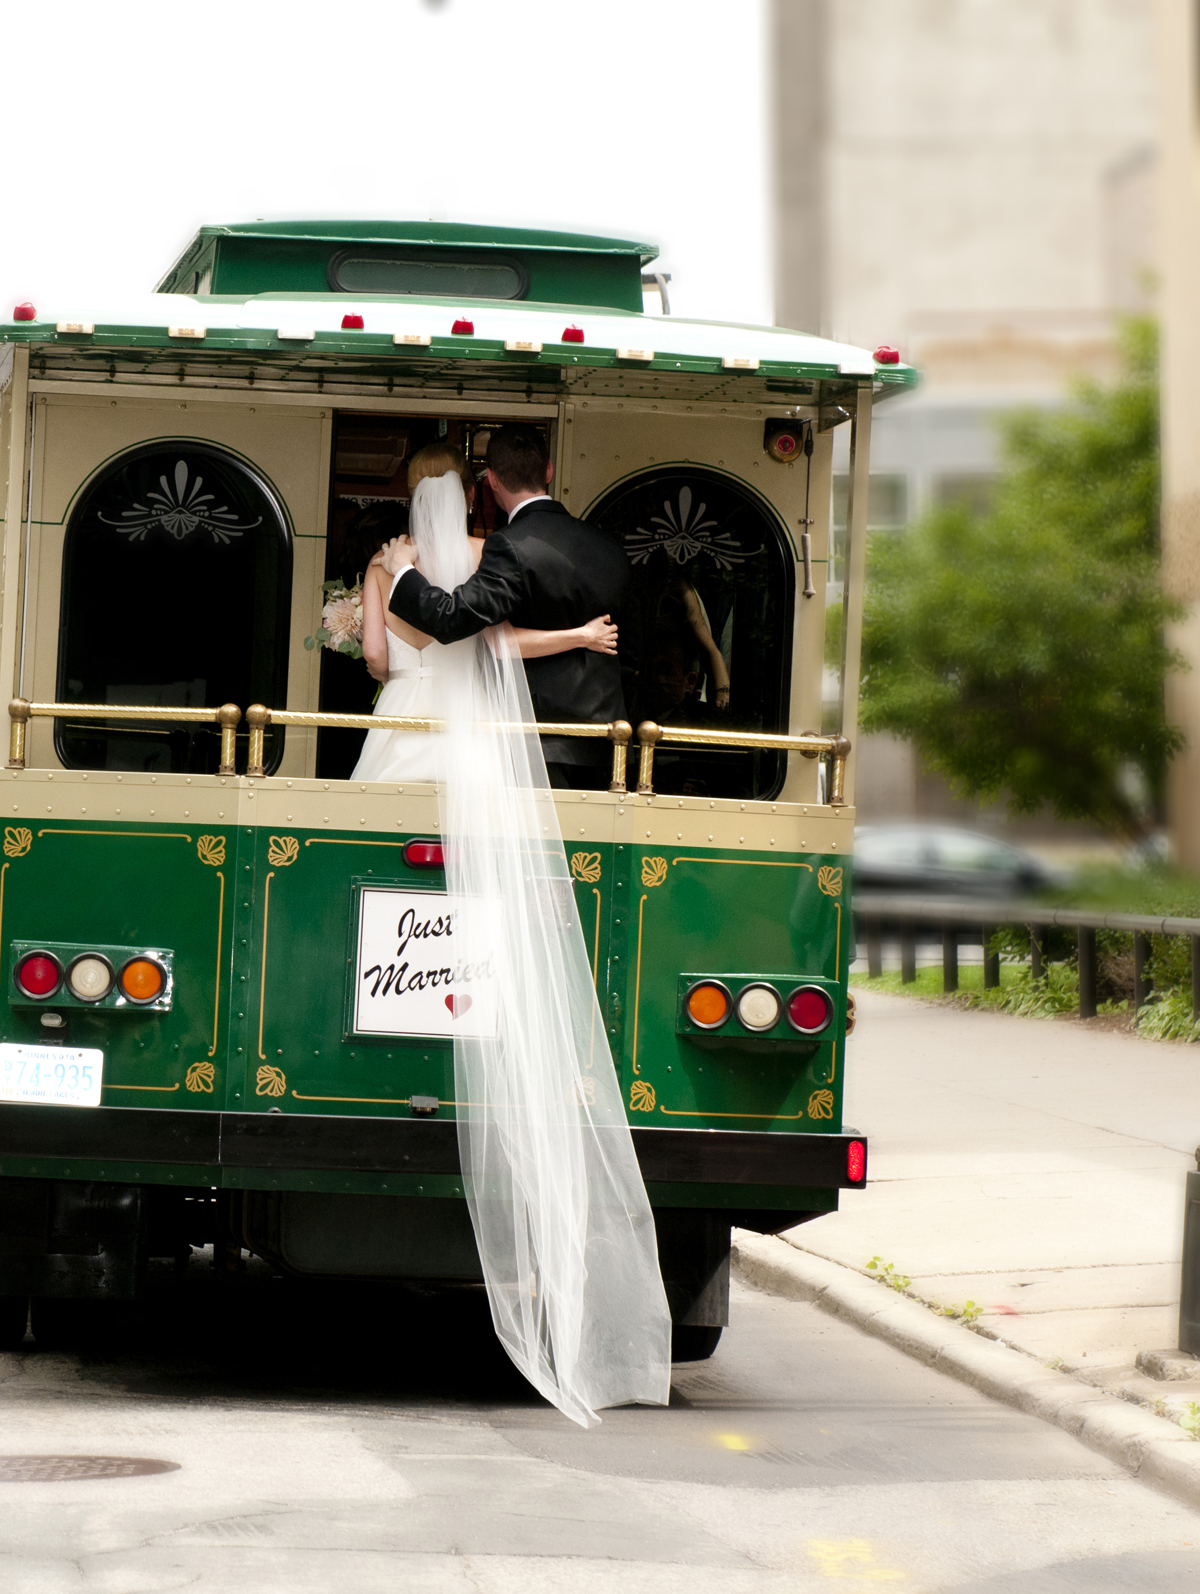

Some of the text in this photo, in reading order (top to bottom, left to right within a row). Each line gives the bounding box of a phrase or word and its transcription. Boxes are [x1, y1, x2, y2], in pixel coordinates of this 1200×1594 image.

[361, 497, 410, 509] STEE
[397, 908, 458, 957] Just
[363, 951, 496, 998] Married
[24, 1052, 75, 1061] MINNESOTA
[16, 1060, 94, 1091] 74-935
[21, 1089, 46, 1097] 0,000
